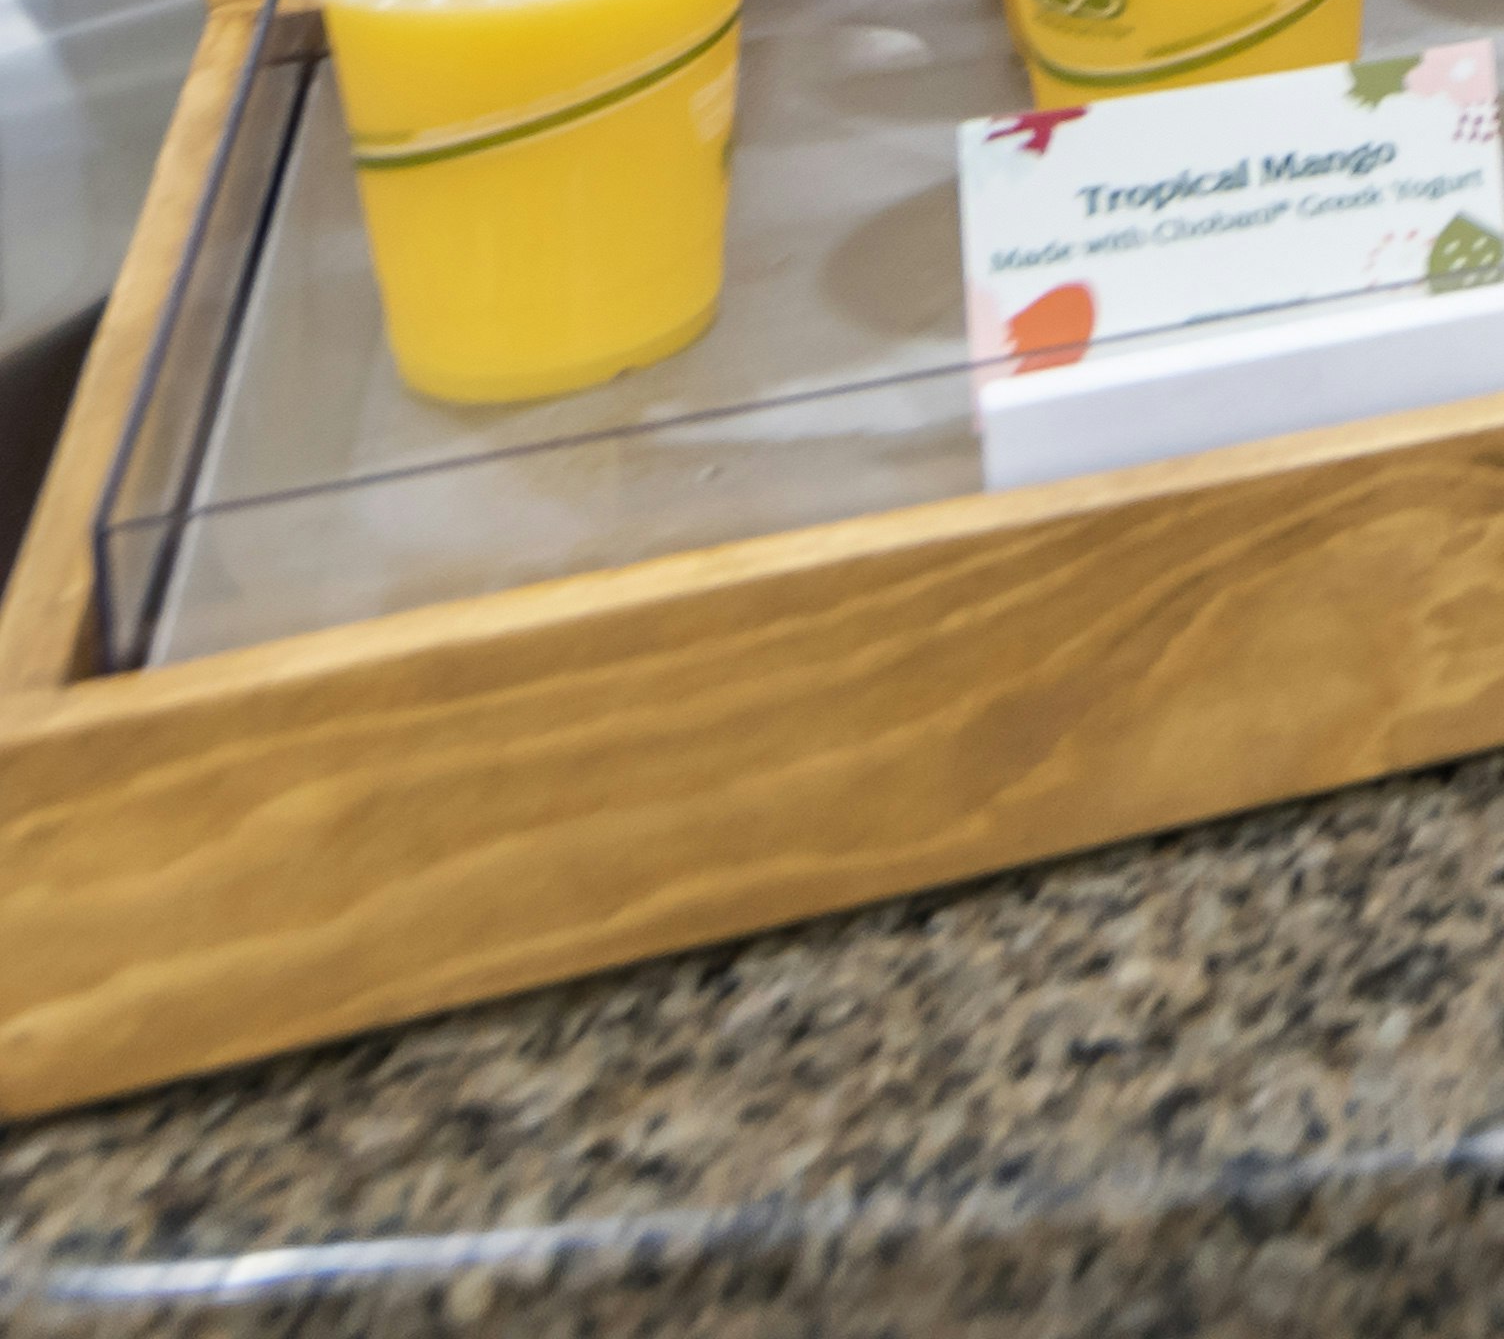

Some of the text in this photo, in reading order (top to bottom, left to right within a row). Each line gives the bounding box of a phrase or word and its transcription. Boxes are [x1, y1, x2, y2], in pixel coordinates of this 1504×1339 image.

[989, 245, 1073, 274] Made
[1082, 225, 1147, 255] with
[1297, 184, 1385, 218] Greek
[1391, 168, 1484, 203] Yogurt
[1077, 140, 1397, 217] Tropical Mango
